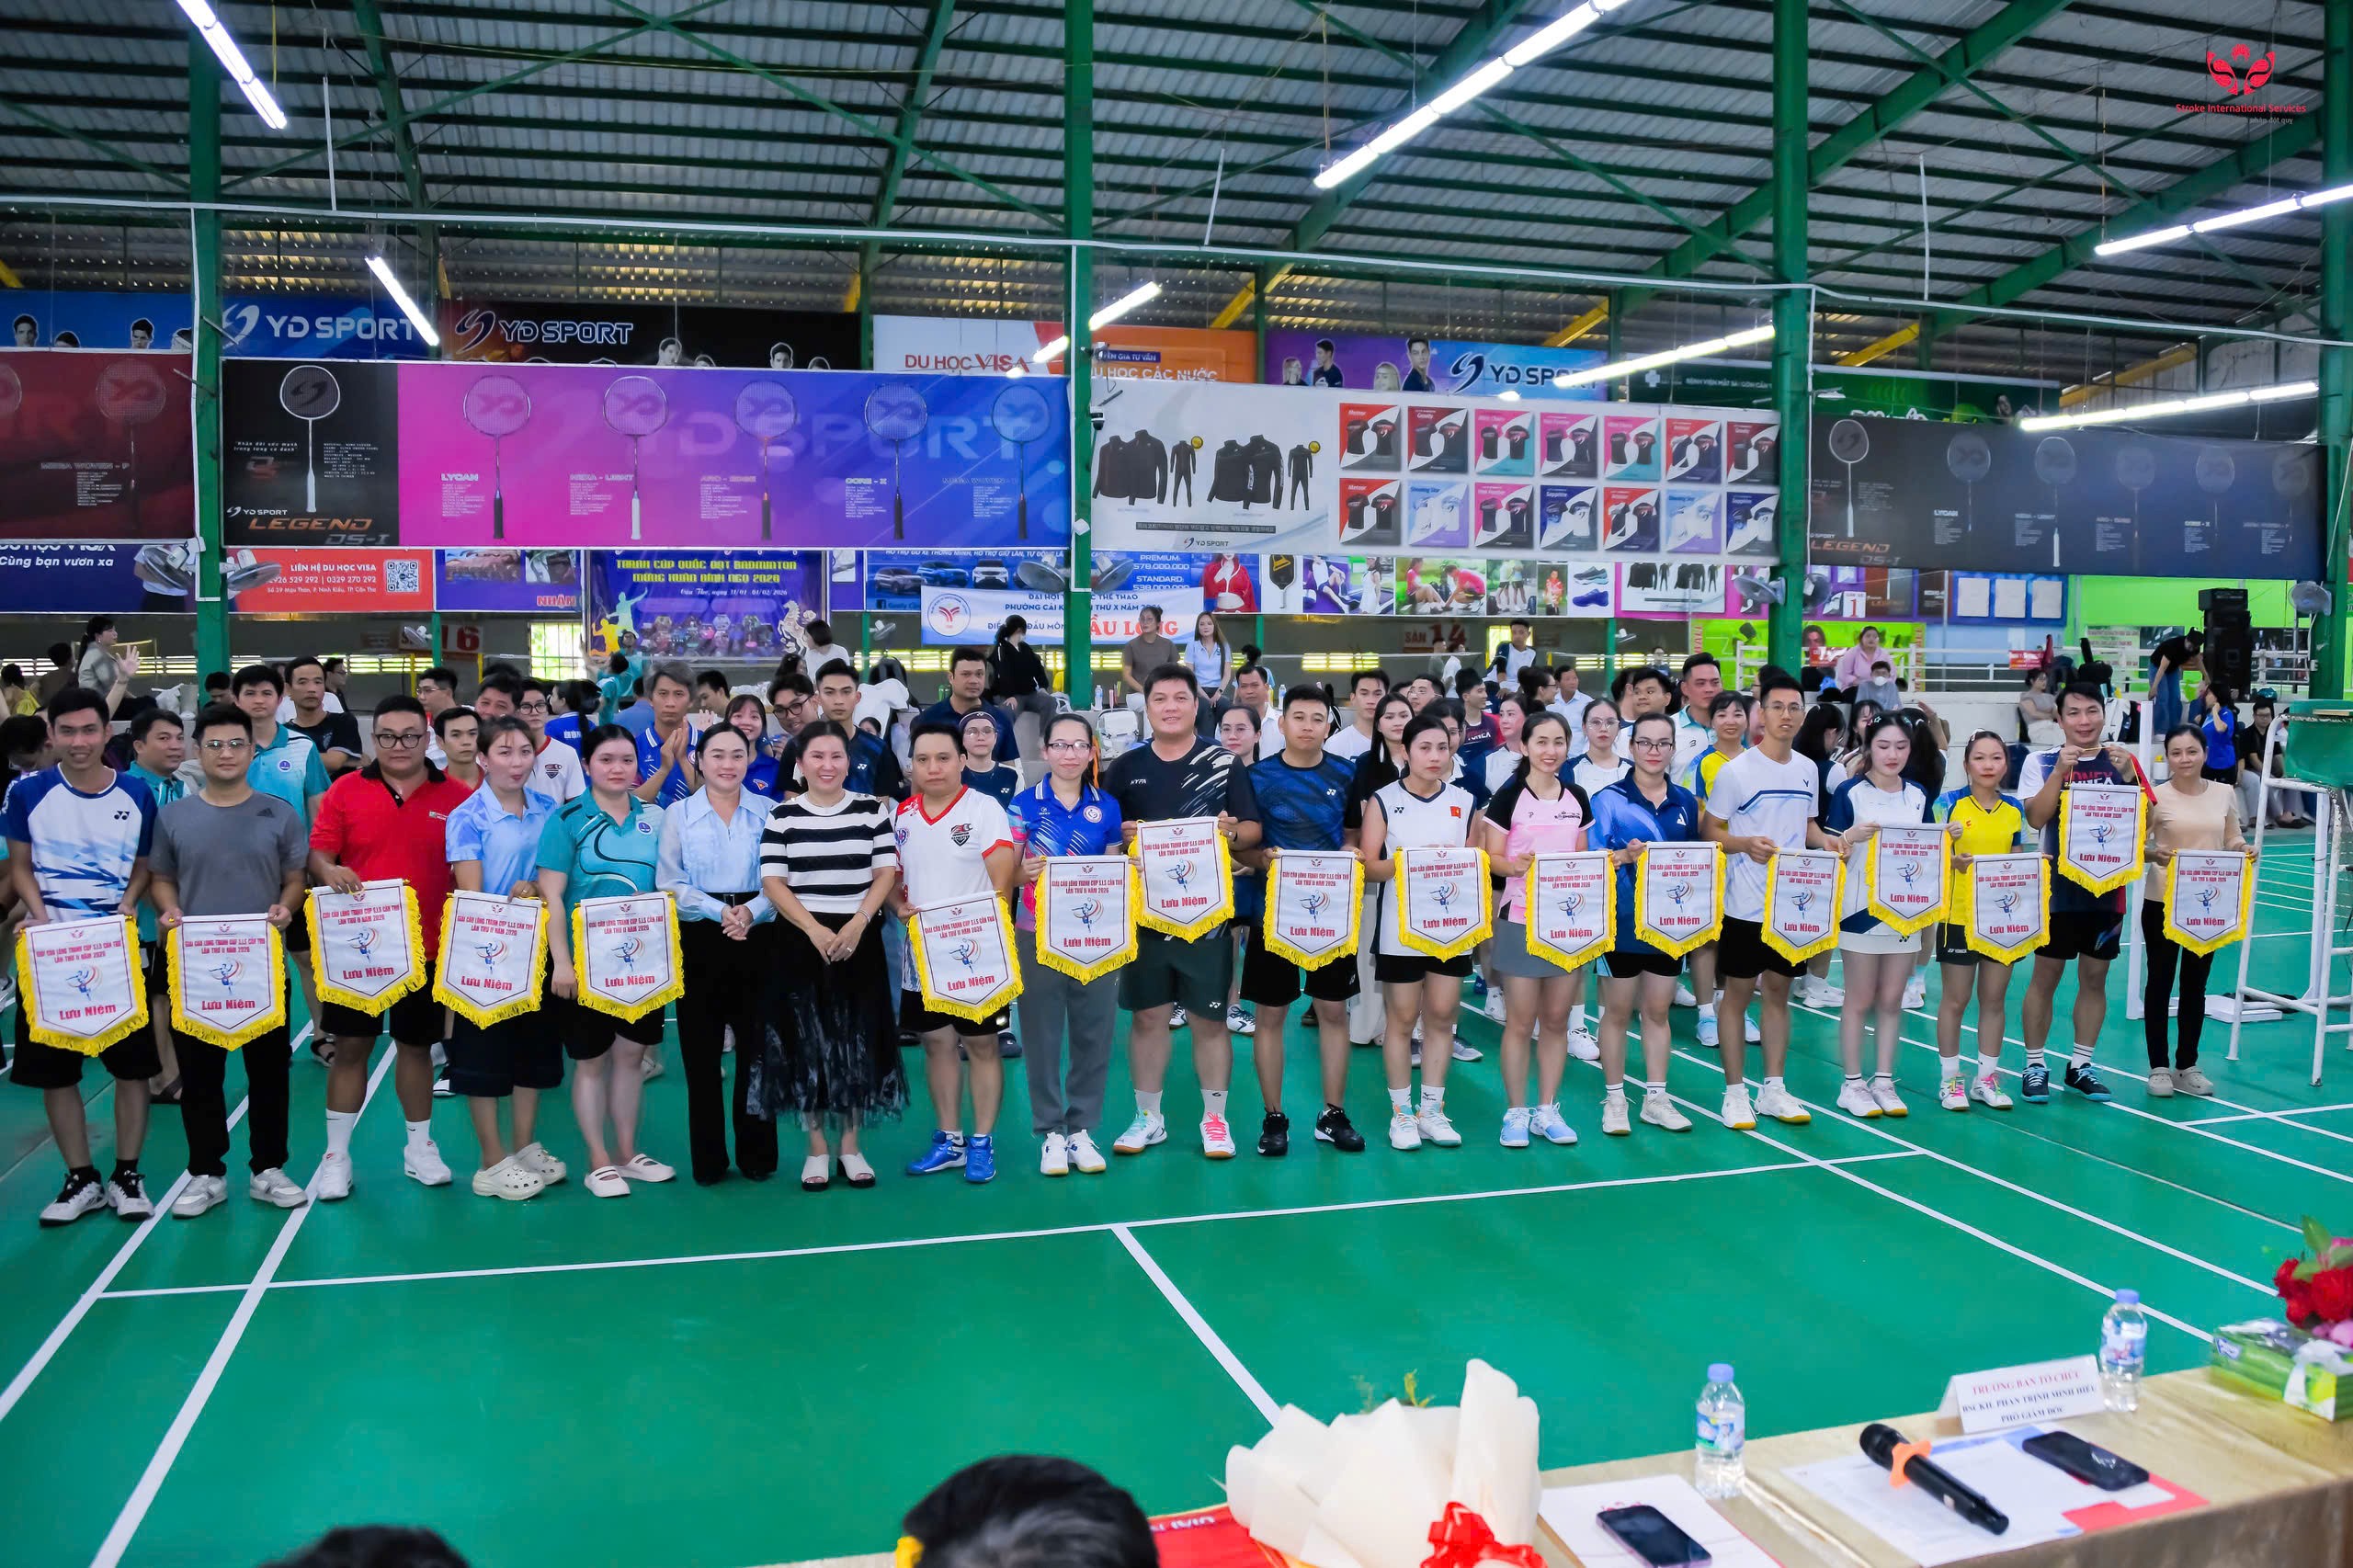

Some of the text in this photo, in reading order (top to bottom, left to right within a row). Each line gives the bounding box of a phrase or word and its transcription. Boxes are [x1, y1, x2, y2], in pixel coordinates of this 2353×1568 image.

[267, 315, 417, 341] YD SPORT
[498, 318, 634, 346] YD SPORT
[904, 353, 929, 369] DU
[974, 353, 1030, 373] VISA
[1490, 365, 1521, 384] YD
[248, 517, 373, 531] LEGEND
[1810, 540, 1890, 553] LEGEND
[0, 555, 32, 568] Cùng
[36, 556, 60, 568] bạn
[97, 558, 114, 567] xa
[290, 562, 309, 572] LIÊN
[311, 562, 321, 574] HỆ
[338, 564, 356, 574] HỌC
[733, 559, 798, 570] BADMINTON
[1136, 575, 1184, 584] STANDARD:
[537, 594, 576, 608] NHẬN
[1120, 603, 1139, 611] NĂM
[1848, 598, 1857, 618] 1
[1090, 614, 1118, 636] ẦU
[1161, 896, 1208, 908] Lưu Niệm
[1423, 917, 1468, 928] Lưu Niệm
[1290, 926, 1336, 937] Lưu Niệm
[1551, 929, 1593, 938] Lưu Niệm
[1063, 937, 1111, 948] Lưu Niệm
[343, 967, 394, 980] Lưu Niệm
[460, 975, 513, 991] Lưu Niệm
[604, 975, 655, 987] Lưu Niệm
[947, 975, 995, 991] Lưu Niệm
[2052, 1389, 2075, 1400] MINH
